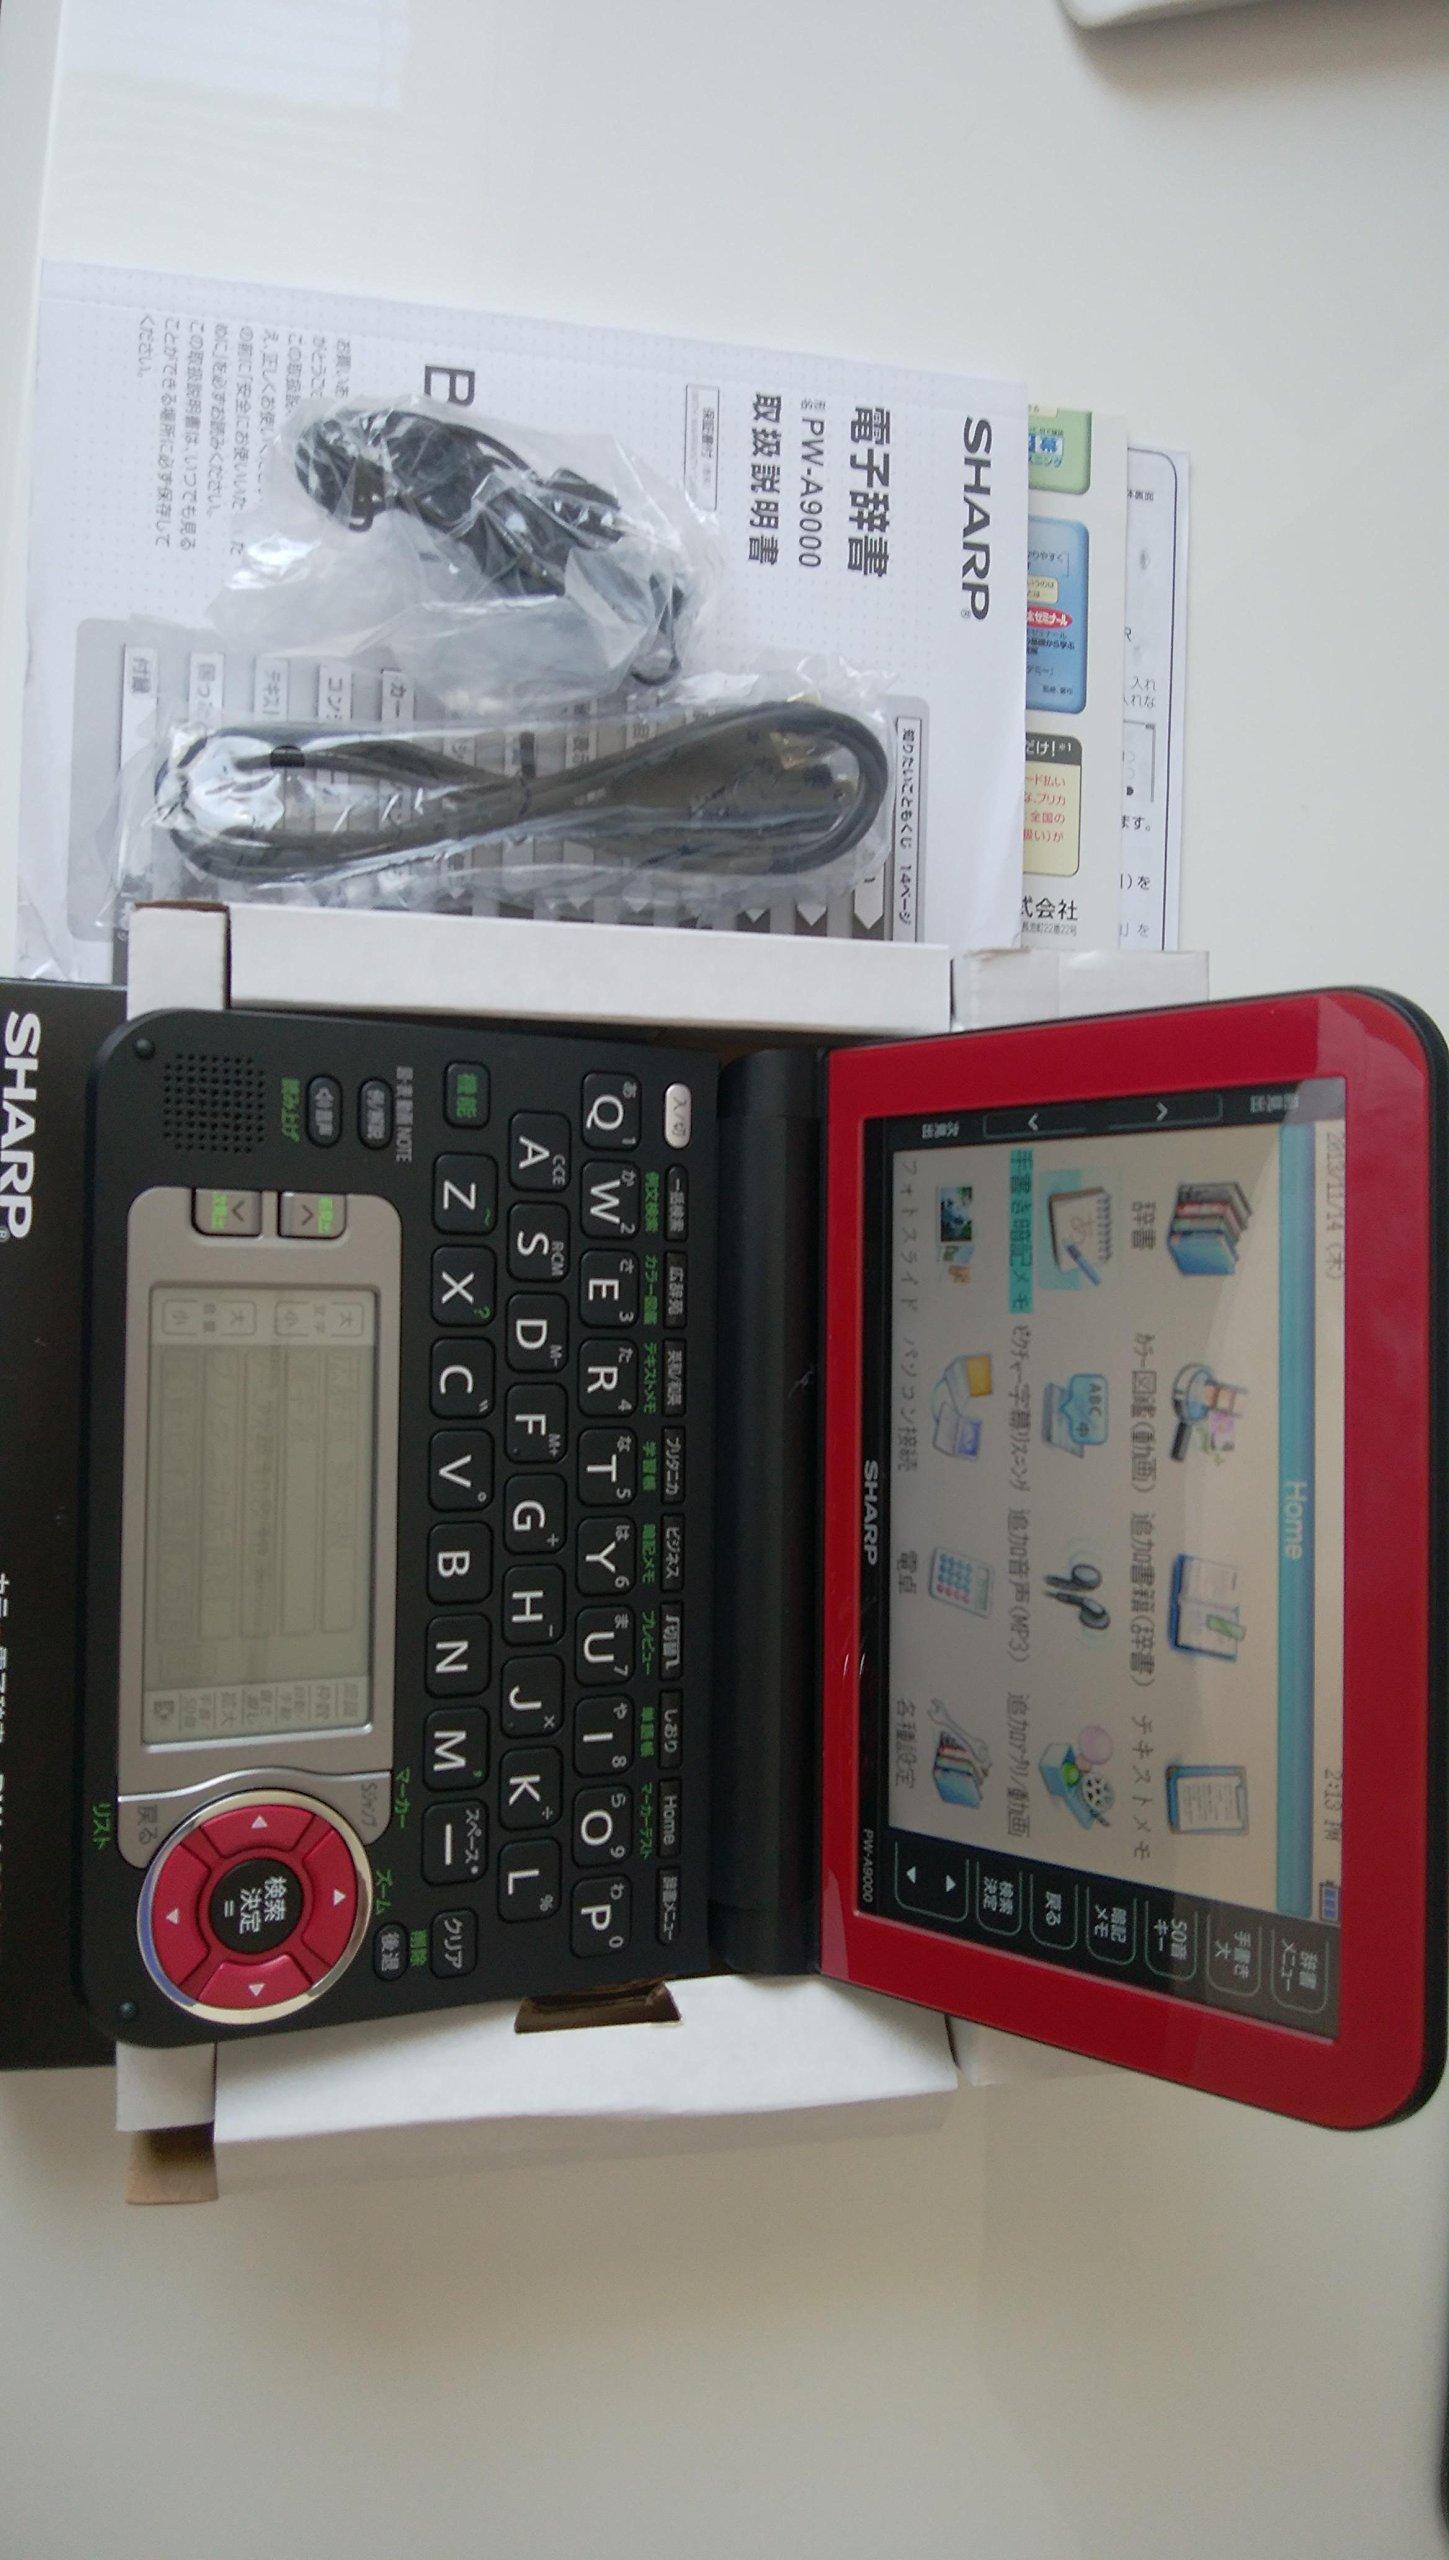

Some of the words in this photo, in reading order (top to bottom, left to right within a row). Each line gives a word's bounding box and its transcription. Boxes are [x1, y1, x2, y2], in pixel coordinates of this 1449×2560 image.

[749, 393, 782, 566] 取扱説明書
[799, 417, 825, 569] PW-A9000
[848, 407, 891, 578] 電子辞書
[899, 729, 916, 849] 知りたいこともくじ
[899, 865, 913, 925] 14ページ
[585, 1094, 624, 1131] Q
[518, 1135, 550, 1170] A
[621, 1136, 637, 1145] 1
[442, 1178, 477, 1211] Z
[589, 1179, 621, 1225] W
[517, 1230, 549, 1256] S
[620, 1222, 636, 1234] 2
[1009, 1150, 1033, 1310] 手書き暗記メモ
[1131, 1200, 1157, 1251] 辞書
[440, 1270, 476, 1305] X
[588, 1277, 620, 1301] E
[618, 1310, 633, 1322] 3
[515, 1318, 548, 1350] D
[439, 1364, 474, 1395] C
[586, 1365, 618, 1393] R
[617, 1399, 633, 1412] 4
[514, 1413, 547, 1436] F
[438, 1454, 472, 1488] V
[586, 1454, 617, 1483] T
[665, 1437, 681, 1496] ブリタニカ
[615, 1487, 631, 1499] 5
[513, 1500, 546, 1532] G
[863, 1459, 878, 1565] SHARP
[1284, 1481, 1308, 1560] Home
[437, 1550, 471, 1579] B
[585, 1541, 616, 1573] Y
[664, 1526, 680, 1579] ビジネス
[614, 1575, 630, 1588] 6
[897, 1550, 918, 1595] 電卓
[511, 1589, 544, 1623] H
[435, 1639, 469, 1674] N
[583, 1631, 615, 1664] U
[612, 1665, 628, 1677] 7
[509, 1685, 543, 1711] J
[582, 1731, 614, 1743] I
[663, 1707, 679, 1754] しおり
[895, 1699, 917, 1789] 各種設定
[432, 1730, 467, 1772] M
[611, 1755, 627, 1768] 8
[394, 1766, 411, 1829] マーカー
[509, 1773, 541, 1806] K
[1131, 1715, 1151, 1861] テキストメモ
[91, 1802, 112, 1850] リスト
[138, 1804, 159, 1845] 戻る
[464, 1809, 481, 1865] スペース
[580, 1809, 613, 1847] O
[663, 1795, 678, 1845] Home
[610, 1845, 625, 1859] 9
[862, 1828, 874, 1903] PW-A9000
[264, 1875, 287, 1922] 検索
[374, 1869, 393, 1916] ズーム
[507, 1868, 541, 1896] L
[983, 1876, 998, 1911] 決定
[999, 1881, 1014, 1916] 検索
[239, 1887, 262, 1935] 決定
[580, 1903, 611, 1931] P
[1045, 1891, 1062, 1926] 戻る
[1094, 1904, 1109, 1938] メモ
[380, 1932, 400, 1972] 後退
[443, 1918, 464, 1969] クリア
[608, 1935, 624, 1949] 0
[1153, 1919, 1169, 1951] キー
[1170, 1919, 1188, 1960] 50音
[1214, 1940, 1231, 1959] 大
[1234, 1930, 1251, 1979] 手書き
[1280, 1939, 1297, 1992] メニュー
